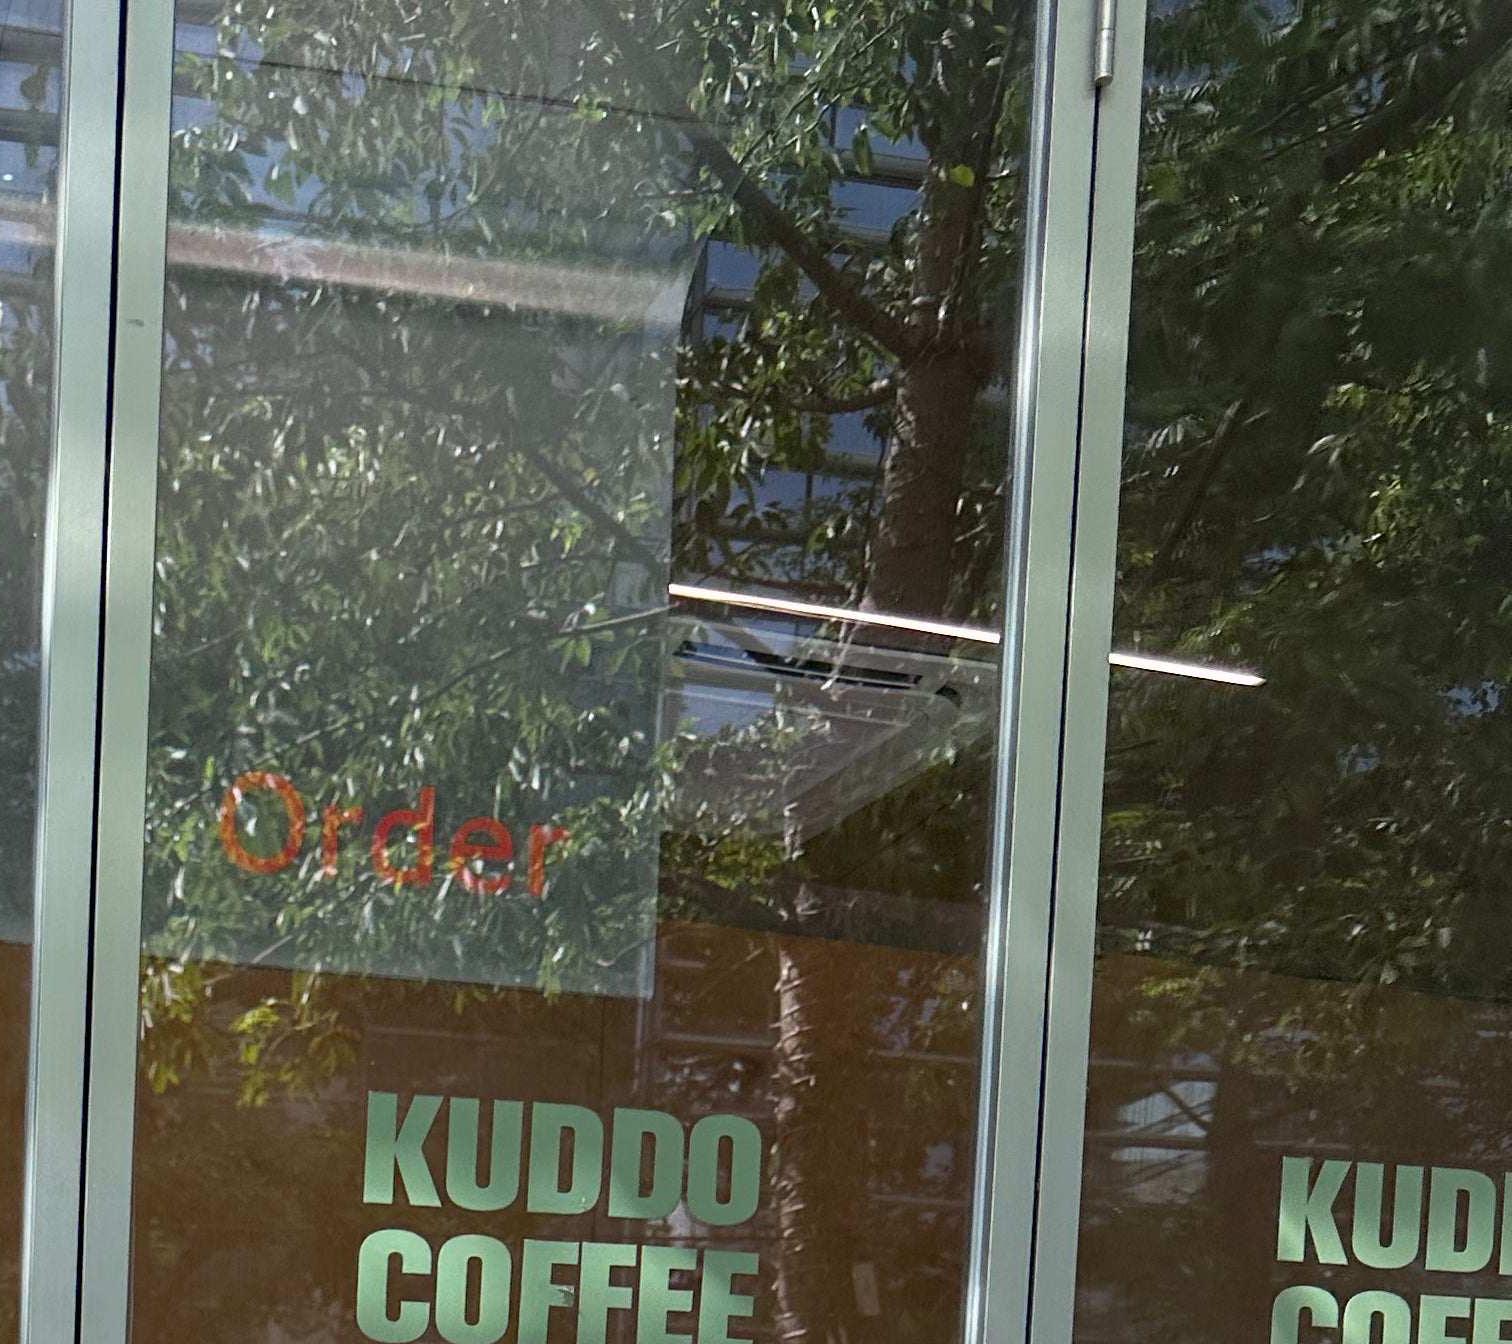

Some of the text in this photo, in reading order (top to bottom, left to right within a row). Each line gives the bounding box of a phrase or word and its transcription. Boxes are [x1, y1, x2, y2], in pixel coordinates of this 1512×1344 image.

[220, 771, 569, 897] Order
[362, 1090, 763, 1226] KUDDO
[1276, 1156, 1512, 1276] KUD
